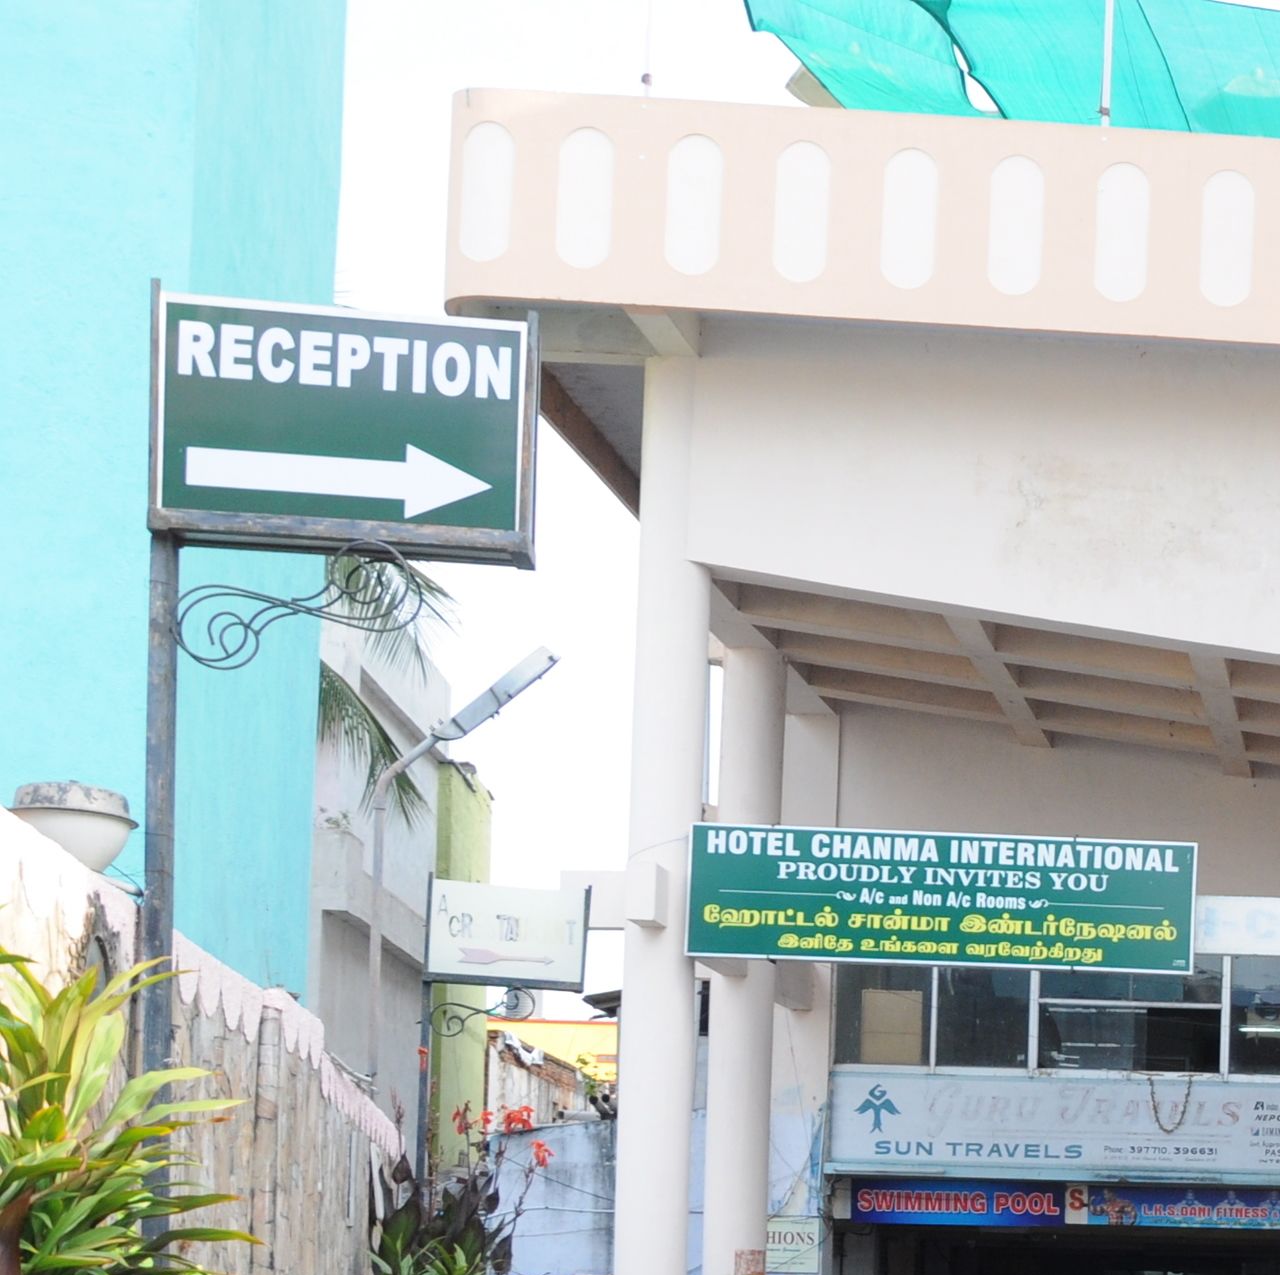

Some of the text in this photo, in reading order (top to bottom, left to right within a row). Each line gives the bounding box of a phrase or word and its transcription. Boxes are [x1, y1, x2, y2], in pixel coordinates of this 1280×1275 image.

[177, 319, 512, 401] RECEPTION
[707, 829, 1179, 873] HOTEL CHANMA INTERNATIONAL
[777, 861, 1109, 892] PROUDLY INVITES YOU
[860, 888, 1026, 910] A/c and Non A/c Rooms
[703, 904, 838, 928] ஹோட்டல்
[848, 908, 950, 932] சான்மா
[778, 933, 853, 952] இனிதே
[874, 1140, 1083, 1160] SUN TRAVELS
[1174, 1147, 1217, 1156] 396631
[857, 1188, 1061, 1216] SWIMMING POOL
[1216, 1206, 1268, 1219] FITNESS
